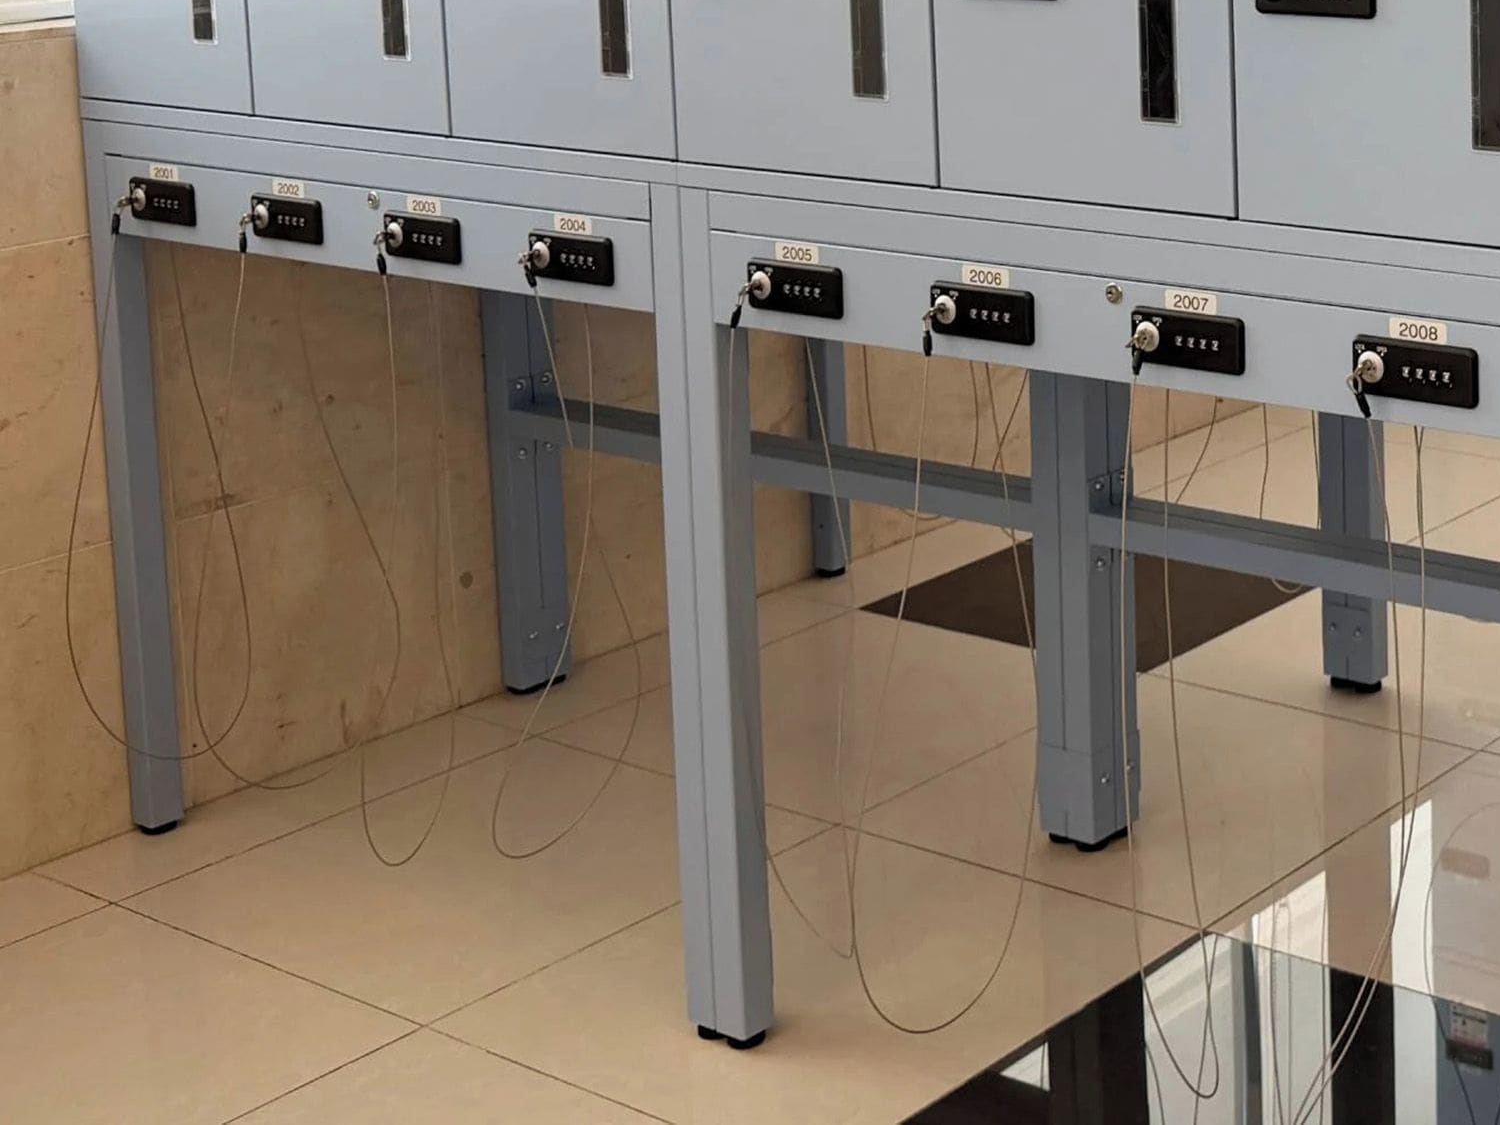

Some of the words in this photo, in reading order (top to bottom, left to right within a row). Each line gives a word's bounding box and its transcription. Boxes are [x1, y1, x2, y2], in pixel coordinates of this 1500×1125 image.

[153, 166, 174, 180] 2001
[277, 181, 299, 195] 2002
[412, 200, 436, 214] 2003
[560, 218, 586, 232] 2004
[782, 246, 812, 262] 2005
[969, 270, 1002, 286] 2006
[1173, 294, 1209, 312] 2007
[1399, 323, 1438, 341] 2008
